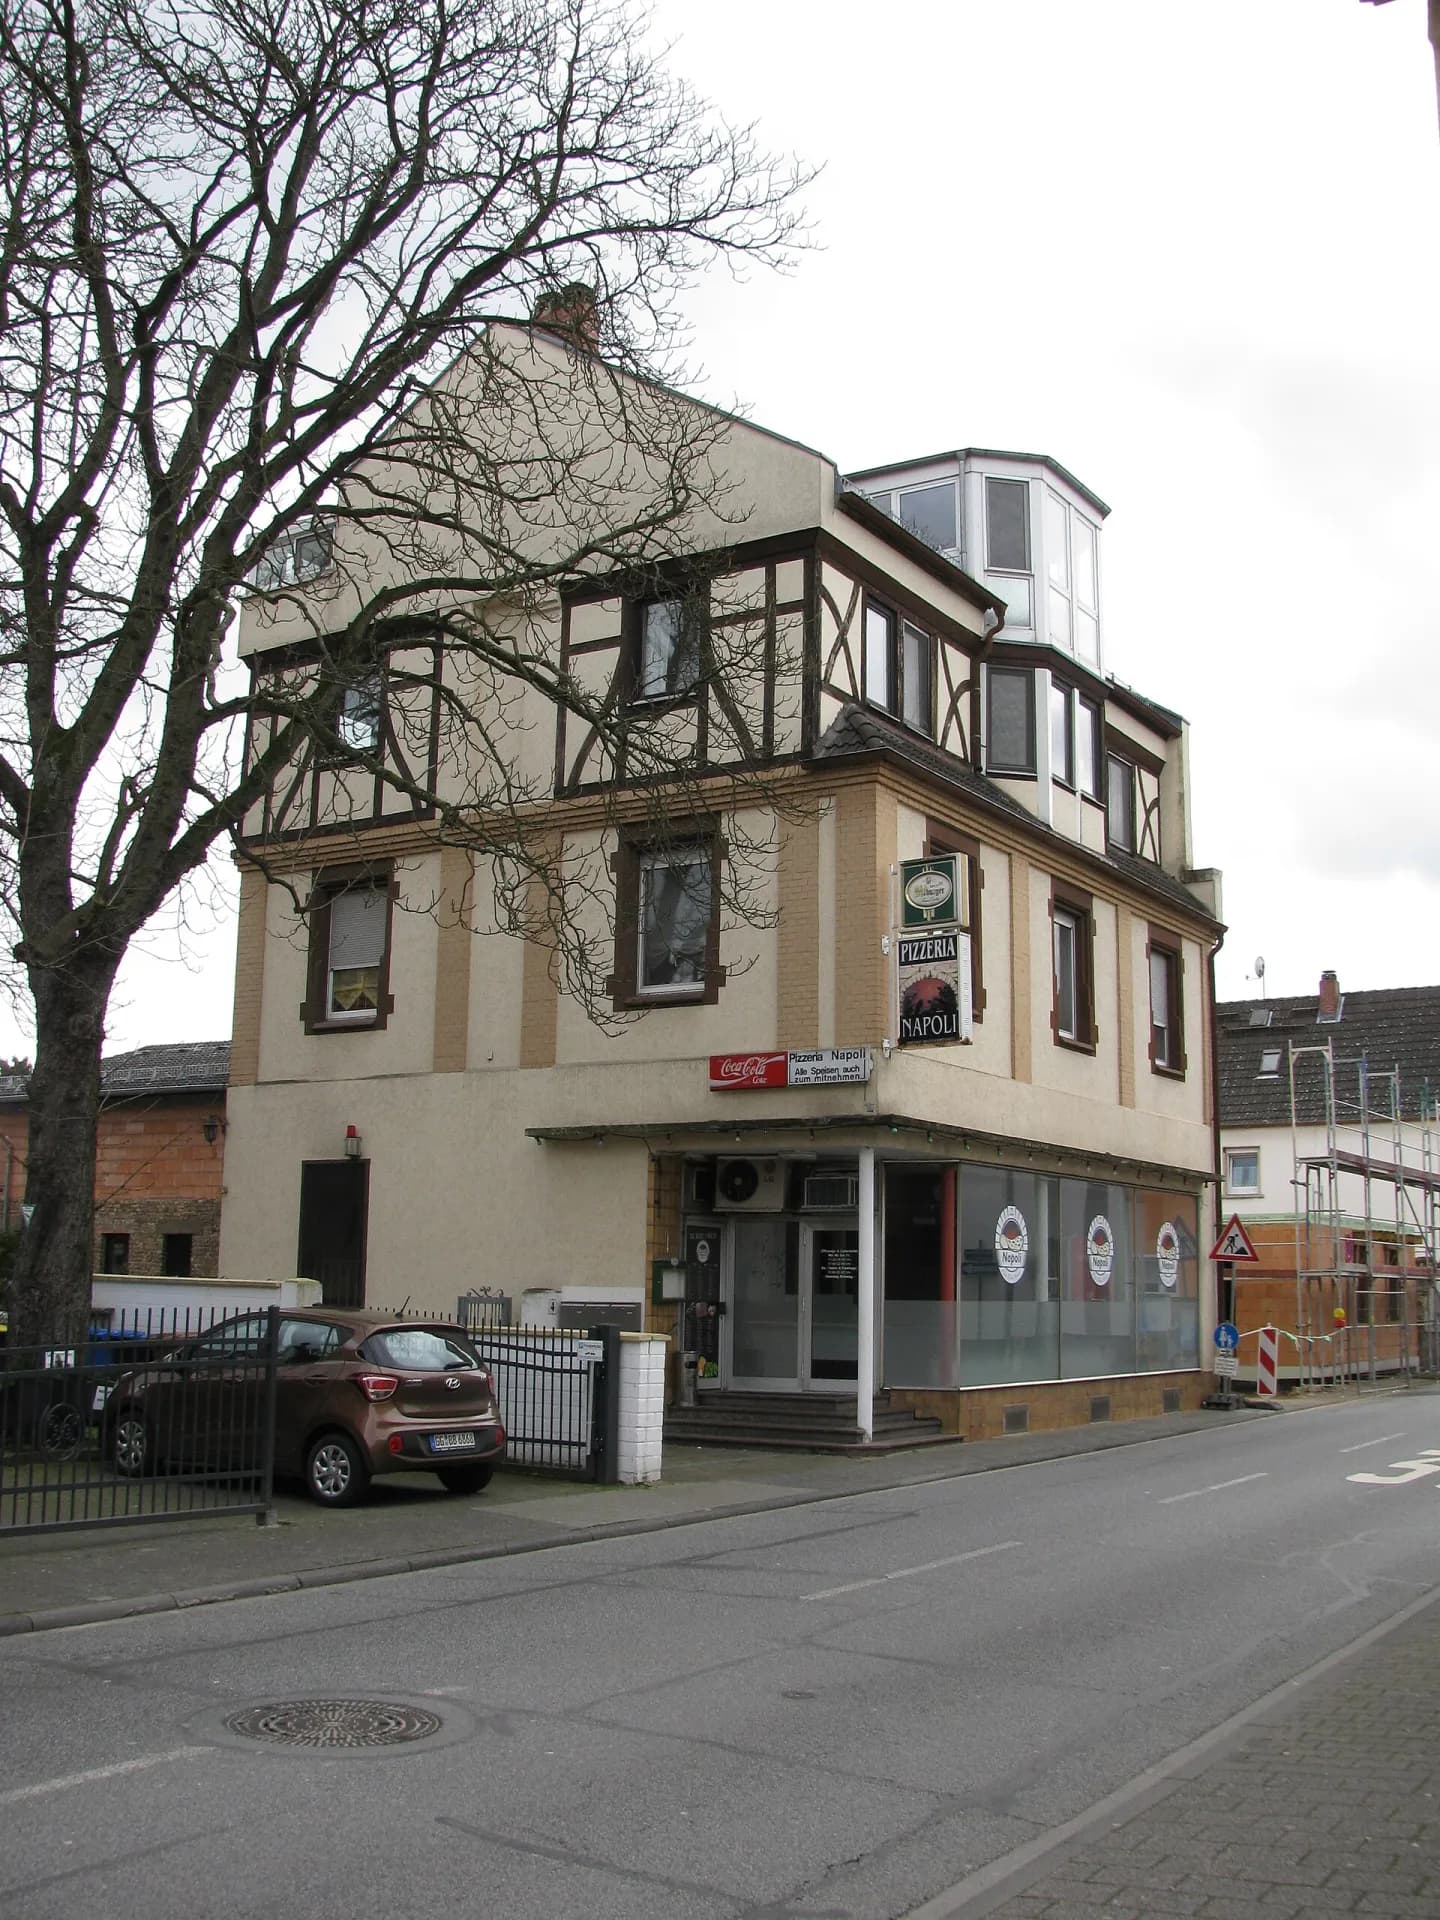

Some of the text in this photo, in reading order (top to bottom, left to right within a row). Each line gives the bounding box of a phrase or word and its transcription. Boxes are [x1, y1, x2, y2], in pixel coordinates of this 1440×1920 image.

[901, 938, 956, 962] PIZZERIA
[902, 1013, 956, 1038] NAPOLI
[789, 1048, 865, 1063] Pizzeria Napoli
[795, 1065, 860, 1076] Alle Speisen auch
[814, 1073, 860, 1082] mitnehmen
[1002, 1251, 1022, 1265] Napoli
